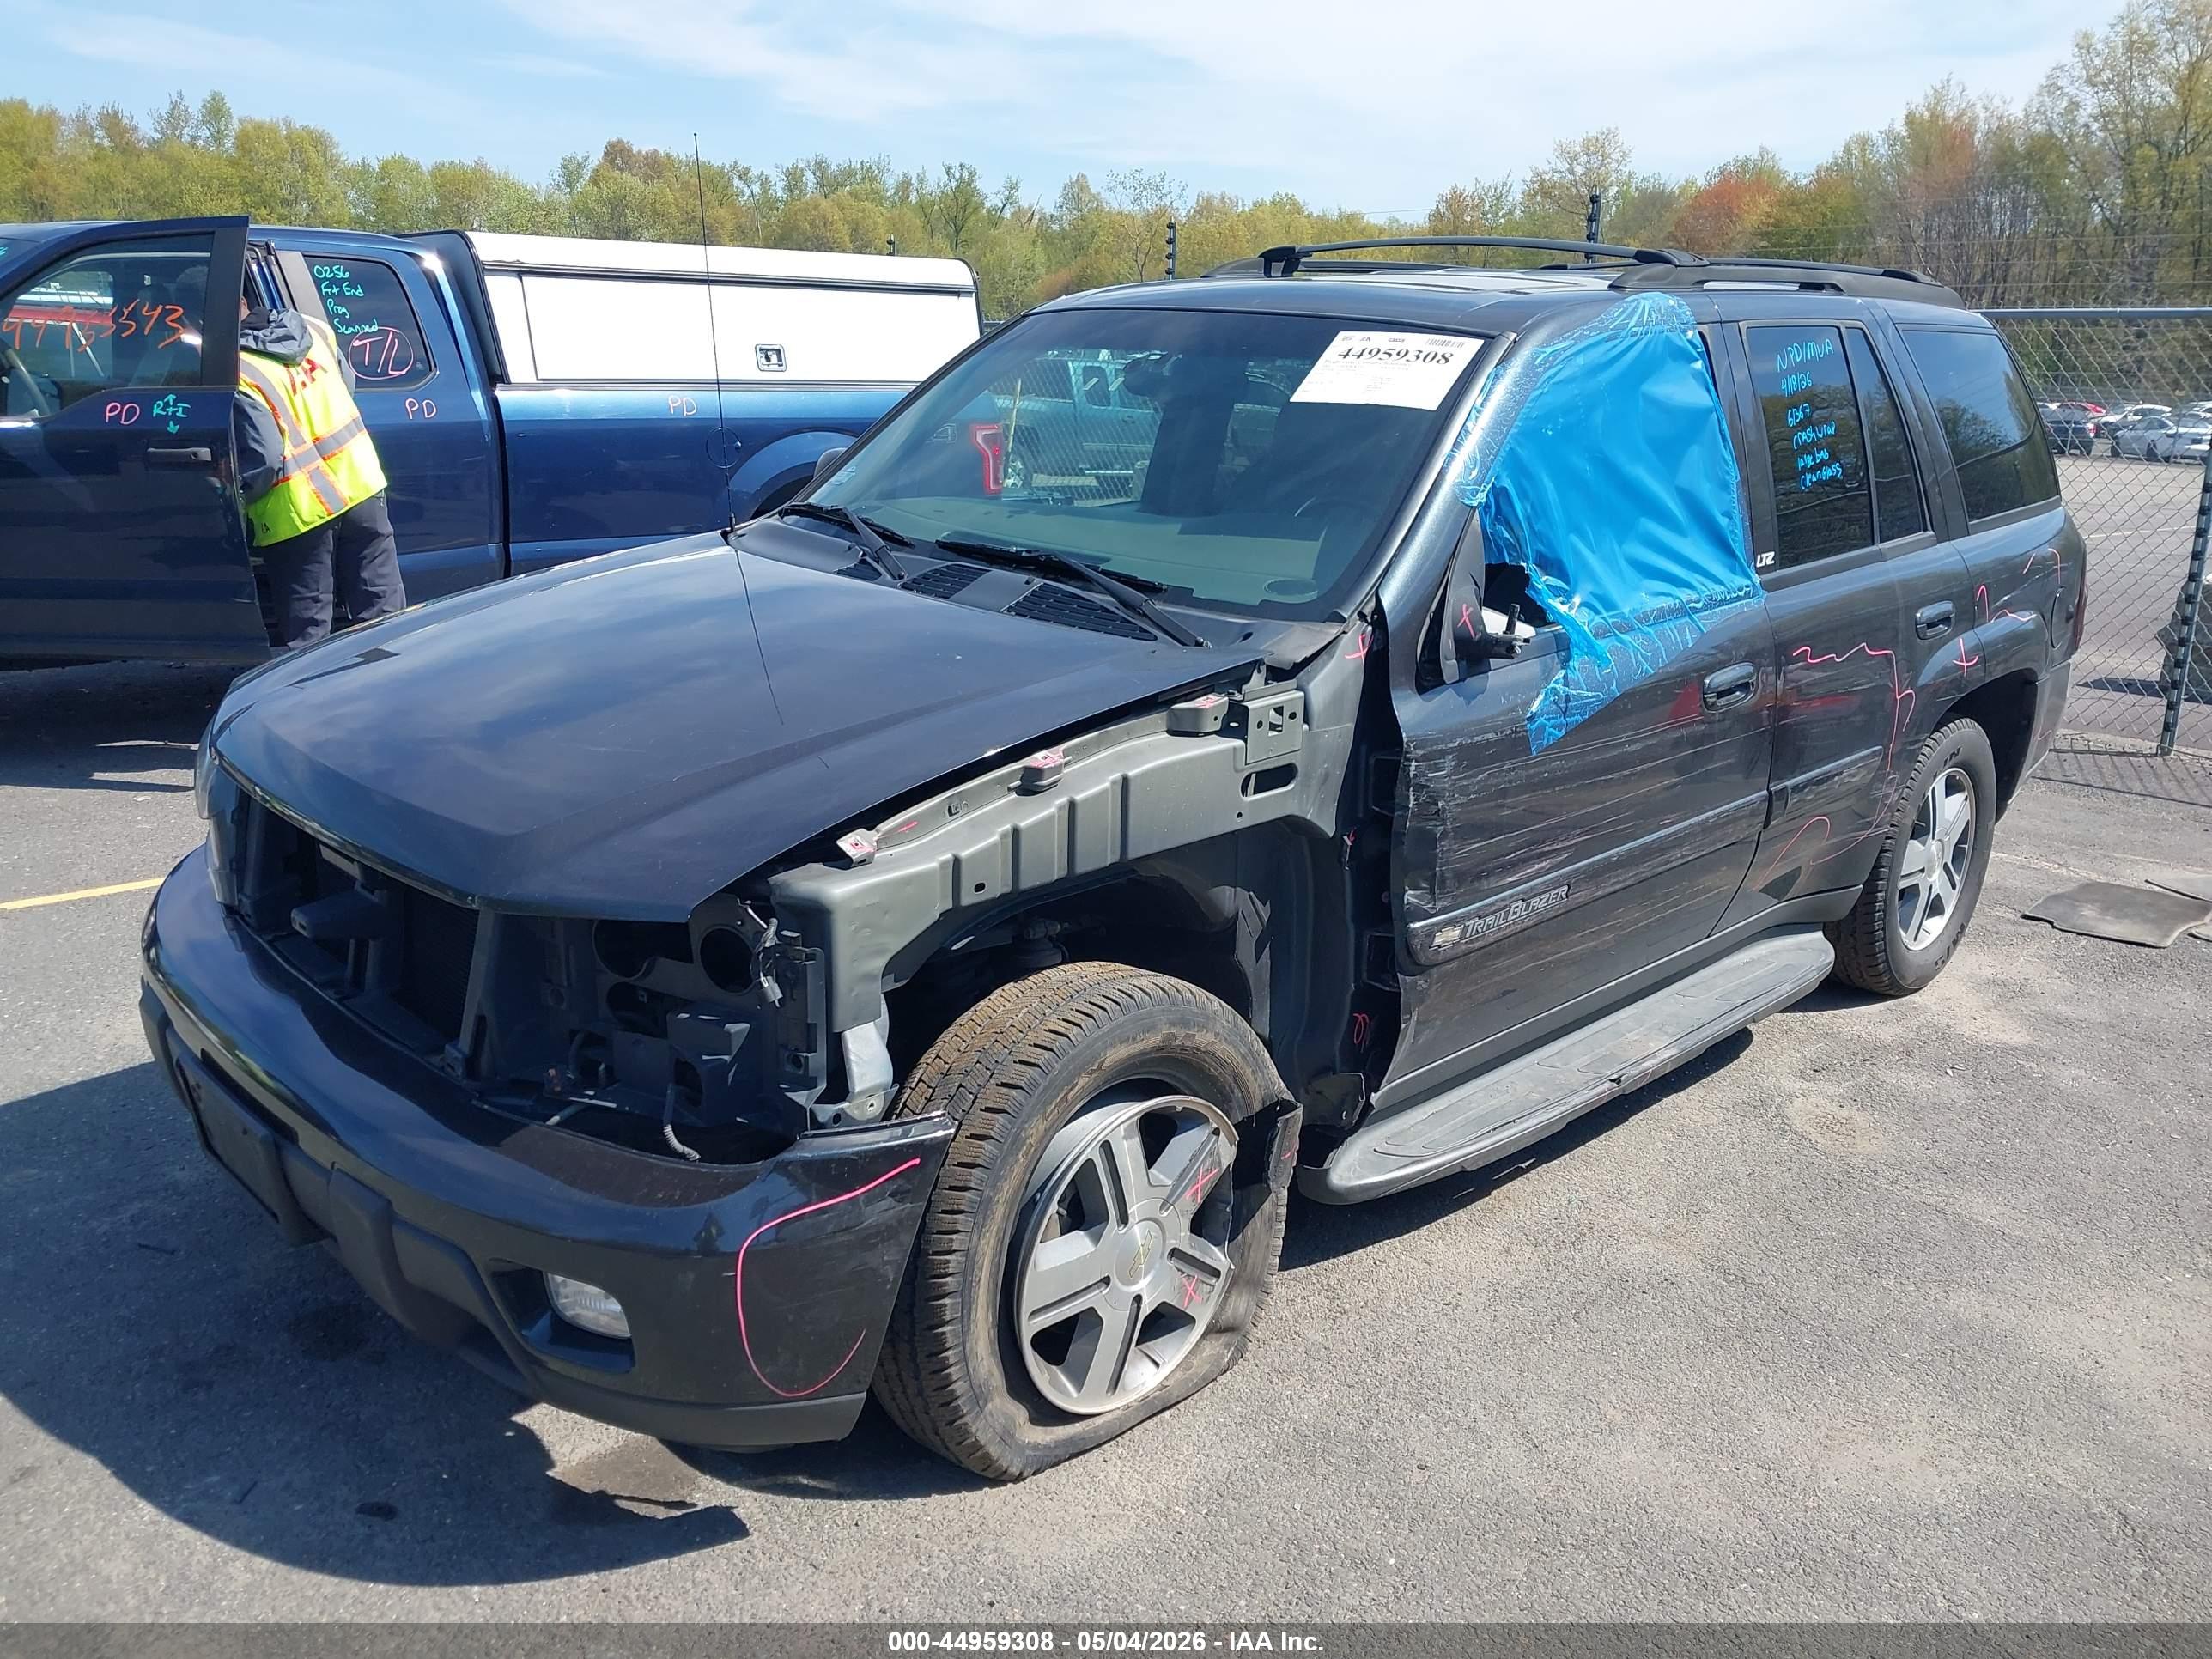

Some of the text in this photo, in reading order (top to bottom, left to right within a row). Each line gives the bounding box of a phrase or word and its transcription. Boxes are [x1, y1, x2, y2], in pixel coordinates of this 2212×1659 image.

[313, 264, 350, 278] 0256
[343, 281, 365, 297] End
[327, 298, 350, 319] Prog
[334, 318, 379, 334] Scanned
[1338, 346, 1455, 365] 44959308
[106, 402, 140, 425] PD
[405, 398, 437, 419] PD
[668, 395, 697, 416] PD
[1756, 550, 1776, 568] LTZ
